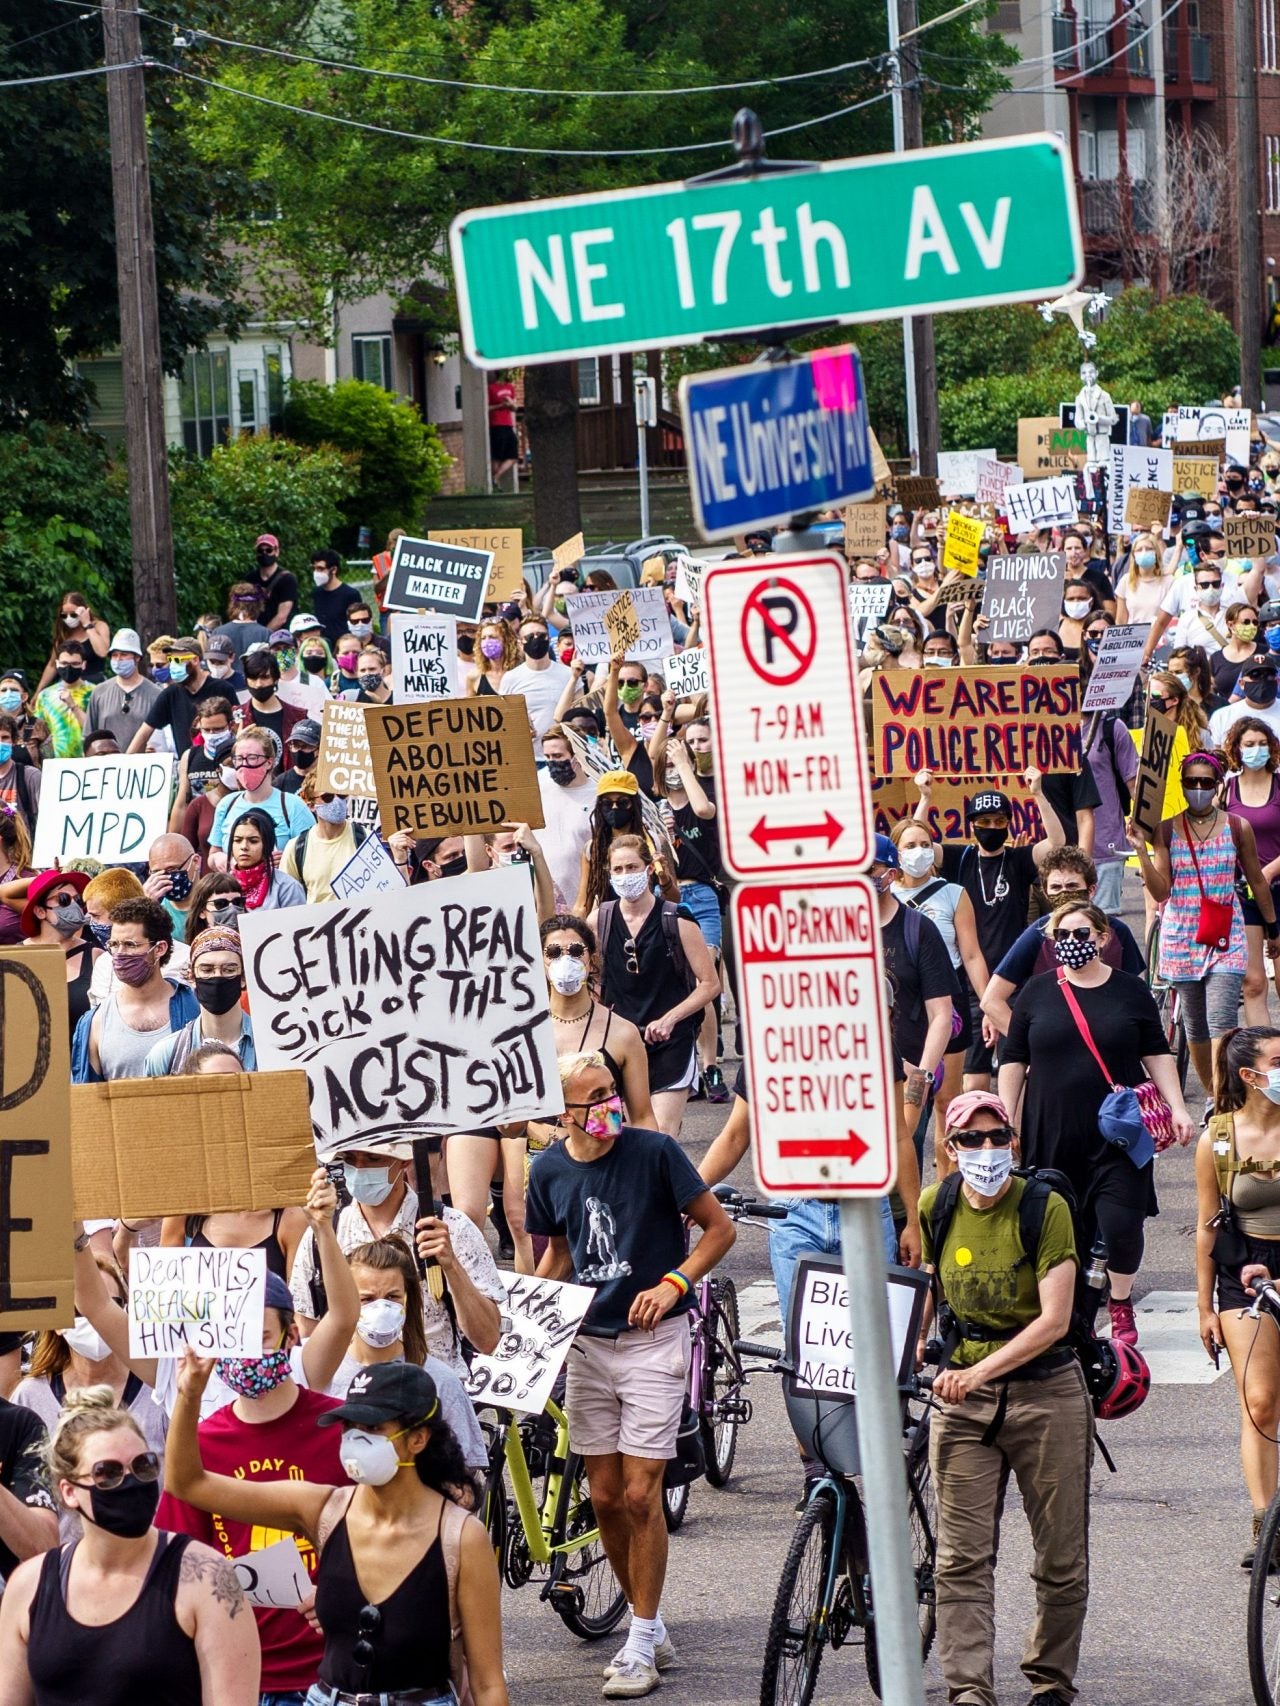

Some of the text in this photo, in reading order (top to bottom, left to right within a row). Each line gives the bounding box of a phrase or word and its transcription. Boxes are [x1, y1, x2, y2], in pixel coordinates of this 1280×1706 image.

[514, 185, 1012, 330] NE 17th Av
[1179, 409, 1201, 420] BLM
[692, 405, 738, 505] NE
[730, 395, 843, 497] University
[987, 461, 1012, 480] STOP
[1038, 456, 1068, 468] POLICE
[1178, 477, 1200, 490] FOR
[1008, 485, 1074, 520] #BLM
[849, 508, 880, 522] black
[855, 523, 877, 534] lives
[1227, 520, 1275, 536] DEFUND
[847, 534, 881, 548] matter
[1227, 536, 1271, 555] MPD
[400, 553, 483, 580] BLACK LIVES
[411, 580, 460, 600] MATTER
[851, 596, 885, 604] IVES
[1018, 581, 1028, 597] 4
[567, 593, 610, 609] WHITE
[606, 591, 632, 629] JUSTICE
[990, 597, 1036, 618] BLACK
[616, 616, 630, 635] FOR
[992, 619, 1034, 639] LIVES
[1107, 627, 1134, 638] POLICE
[403, 628, 449, 657] BLACK
[639, 638, 662, 652] DO!
[1102, 639, 1144, 650] ABOLITION
[410, 657, 445, 675] LIVES
[683, 662, 698, 677] IS
[1099, 655, 1118, 665] NOW
[404, 674, 451, 694] MATTER
[671, 672, 708, 696] ENOUG
[1092, 670, 1131, 680] #JUSTICE
[879, 673, 1079, 720] WE ARE PAST
[1089, 684, 1106, 694] FOR
[329, 704, 365, 722] THOS
[1085, 696, 1117, 708] GEORGE
[382, 706, 507, 742] DEFUND.
[750, 702, 825, 743] 7-9AM
[326, 736, 348, 750] THE
[882, 720, 1082, 775] POLICE REFORM
[325, 751, 360, 766] WILL
[387, 740, 509, 774] ABOLISH.
[59, 763, 167, 802] DEFUND
[390, 768, 508, 799] IMAGINE.
[743, 755, 841, 797] MON-FRI
[395, 799, 512, 831] REBUILD.
[61, 811, 147, 857] MPD
[340, 840, 385, 899] Abolish
[441, 904, 535, 970] REAL
[741, 902, 869, 954] NO PARKING
[436, 966, 536, 1022] THIS
[762, 970, 859, 1009] DURING
[764, 1022, 869, 1063] CHURCH
[467, 1009, 551, 1114] SHIT
[766, 1073, 875, 1113] SERVICE
[137, 1250, 258, 1292] Dear MPLS,
[810, 1280, 850, 1308] Bla
[140, 1321, 246, 1355] HIM SIS!
[805, 1321, 855, 1350] Live
[802, 1361, 857, 1391] Matt
[249, 1458, 284, 1473] DAY
